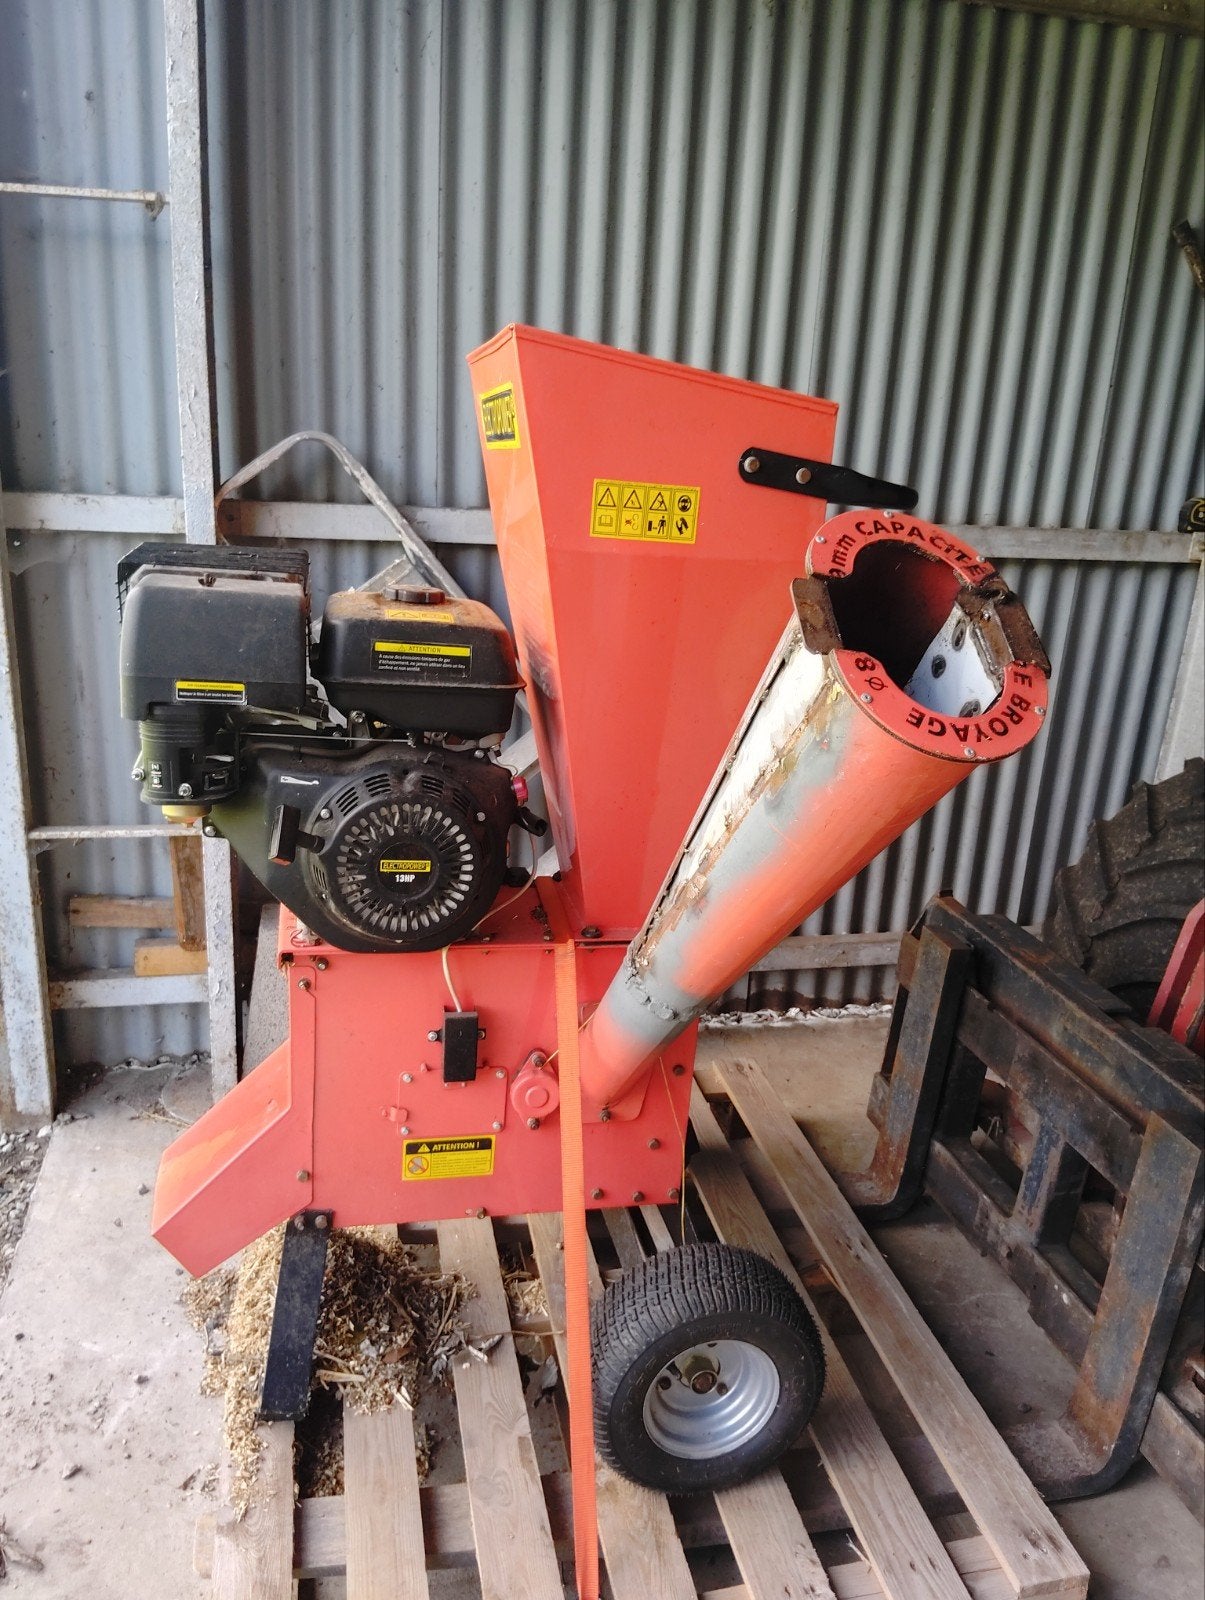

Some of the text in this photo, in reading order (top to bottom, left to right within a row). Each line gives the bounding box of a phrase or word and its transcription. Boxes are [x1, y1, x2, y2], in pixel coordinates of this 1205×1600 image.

[854, 519, 986, 578] CAPACITE
[905, 692, 1032, 743] BROYAGE
[395, 874, 416, 882] 13HP
[432, 1142, 475, 1151] ATTENTION
